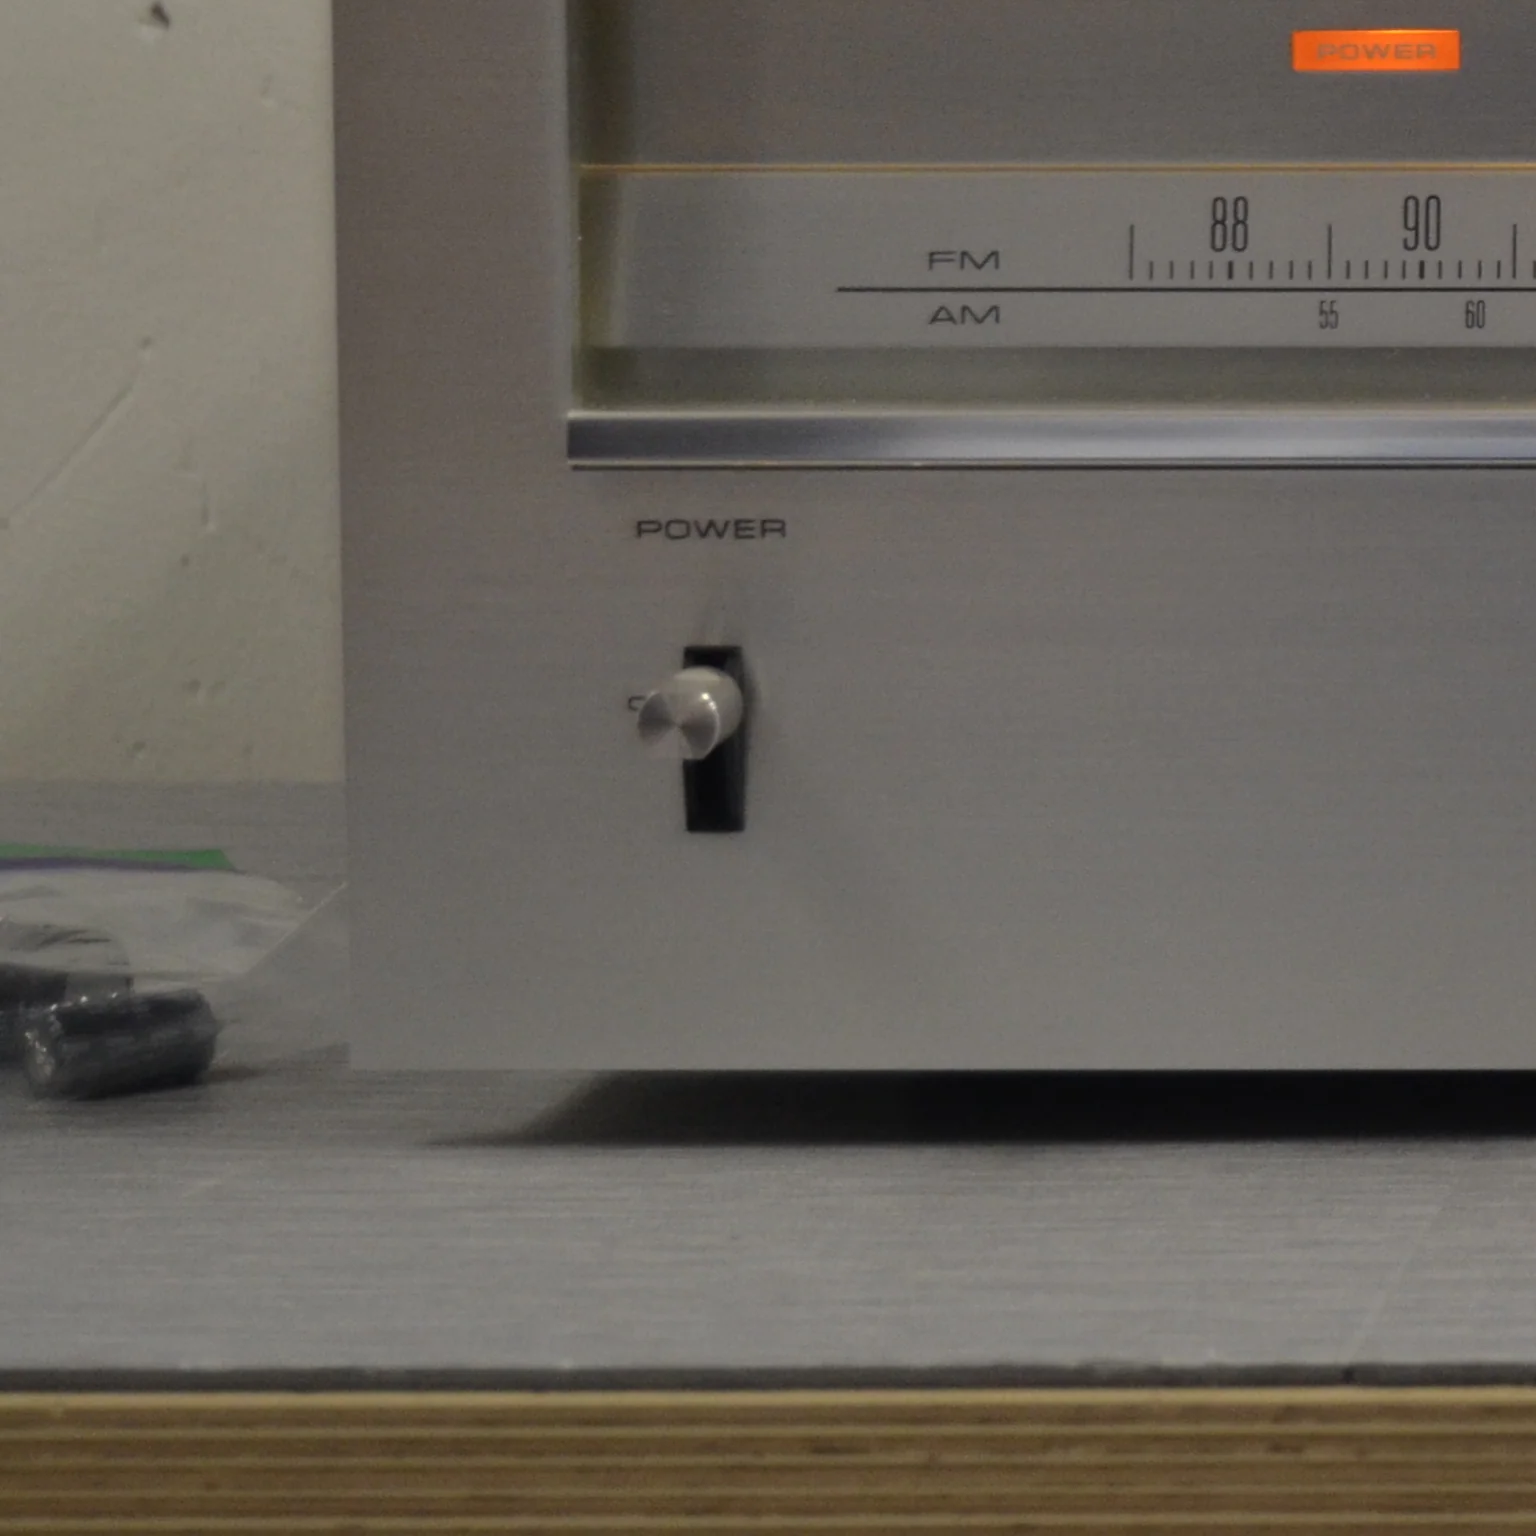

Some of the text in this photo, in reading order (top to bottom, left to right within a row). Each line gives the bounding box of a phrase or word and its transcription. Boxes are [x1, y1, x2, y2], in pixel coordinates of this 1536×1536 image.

[1315, 43, 1438, 60] POWER
[927, 249, 1000, 271] FM
[1210, 195, 1249, 253] 88
[1402, 194, 1442, 252] 90
[927, 304, 1001, 326] AM
[1318, 299, 1339, 330] 55
[1464, 299, 1486, 330] 60
[635, 518, 786, 541] POWER
